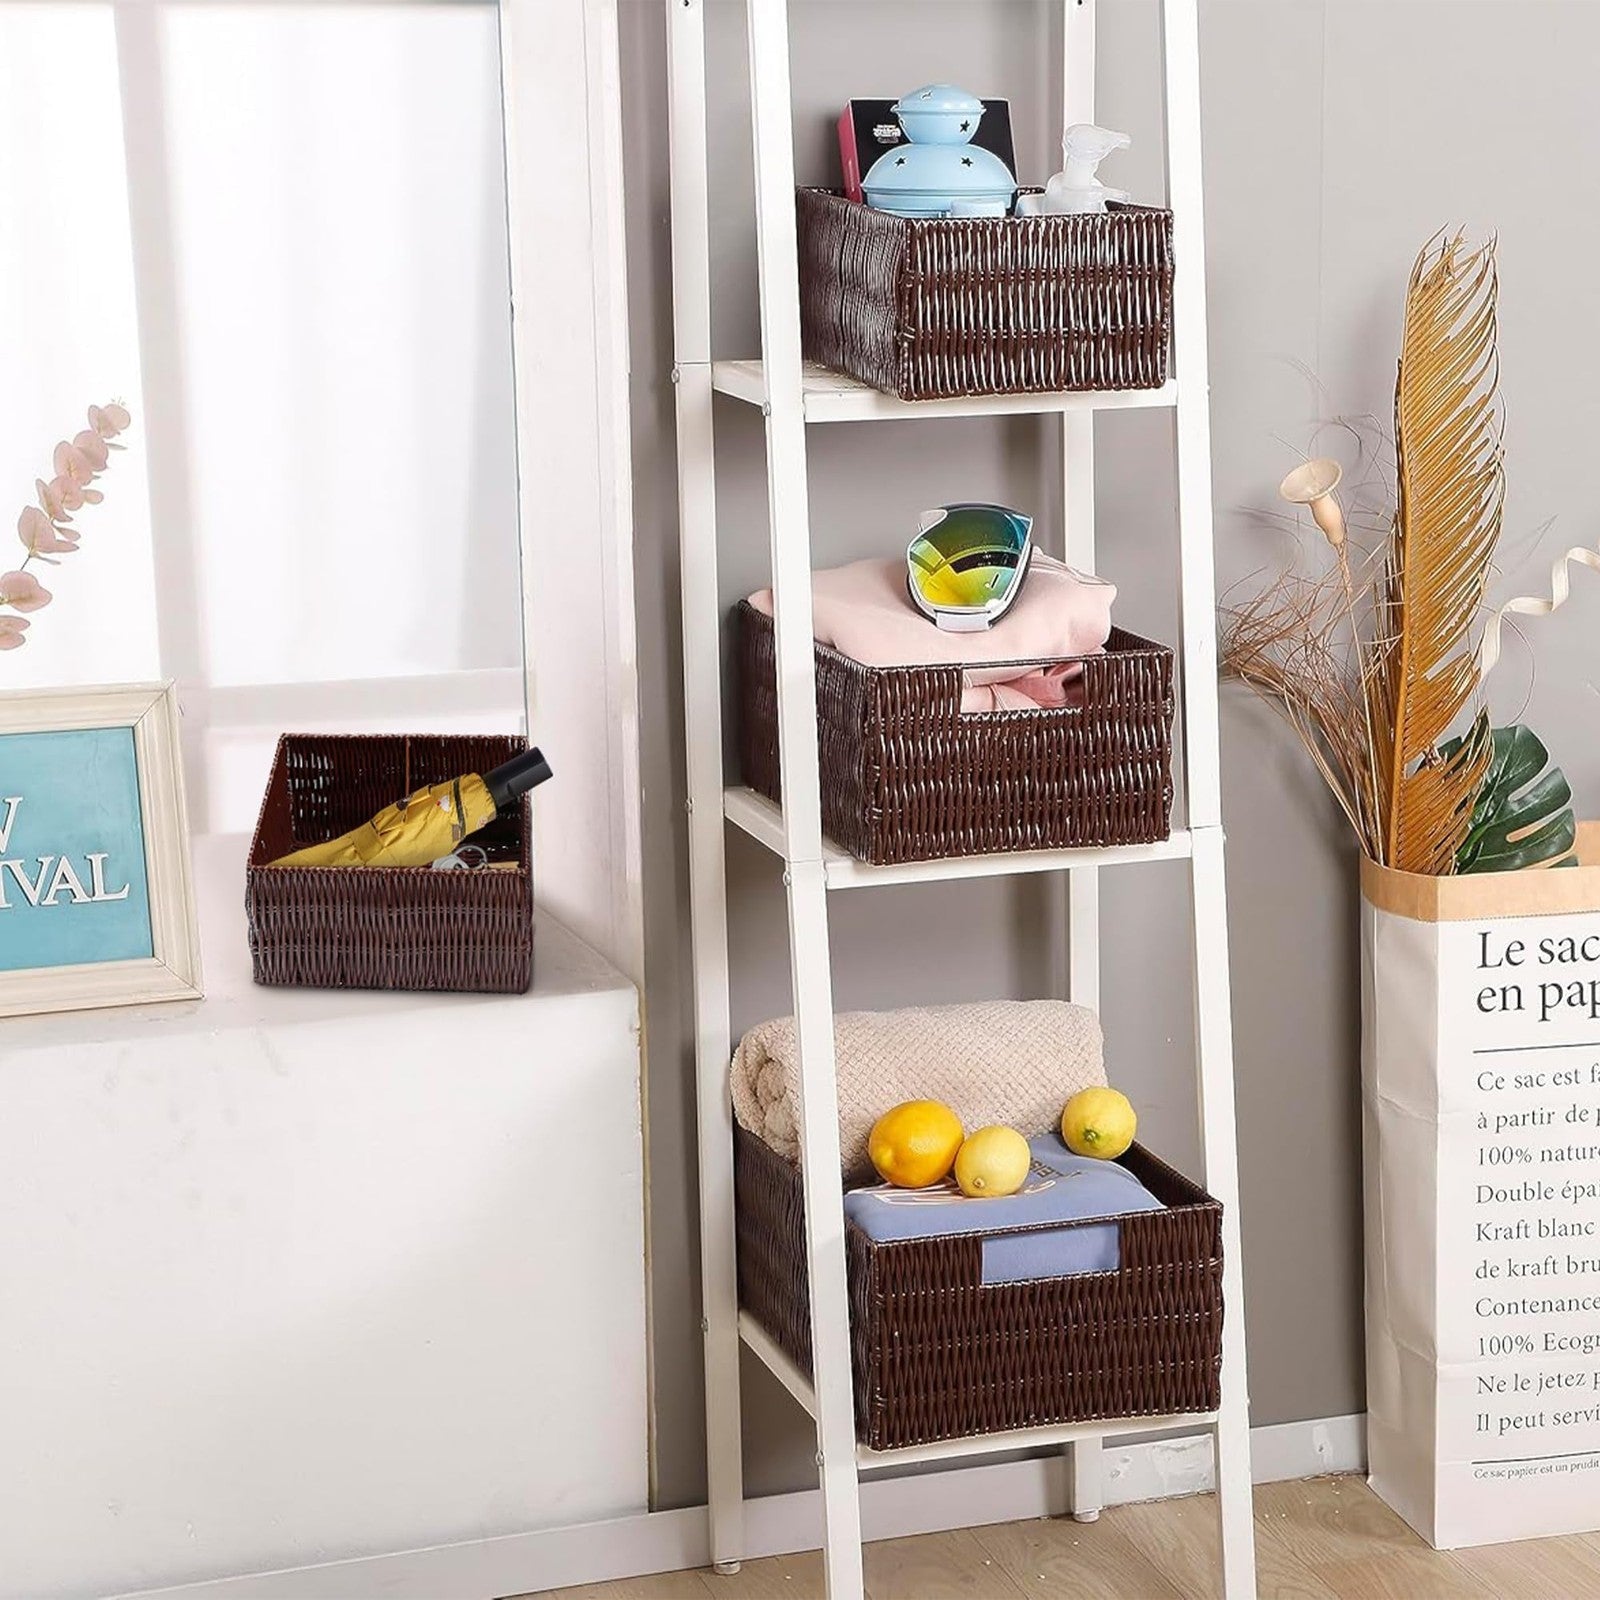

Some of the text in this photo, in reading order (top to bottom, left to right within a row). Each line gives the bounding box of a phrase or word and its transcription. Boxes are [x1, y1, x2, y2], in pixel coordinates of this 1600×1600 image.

[1476, 930, 1600, 970] Le sac
[1476, 984, 1526, 1014] en
[1476, 1071, 1505, 1092] Ce
[1514, 1073, 1546, 1090] sac
[1552, 1068, 1581, 1087] est
[1477, 1111, 1488, 1130] à
[1495, 1105, 1556, 1134] partir
[1564, 1103, 1590, 1124] de
[1479, 1144, 1600, 1167] 100% natur
[1475, 1179, 1600, 1205] Double épa
[1475, 1217, 1595, 1242] Kraft blanc
[1474, 1254, 1600, 1280] de kraft bru
[1475, 1294, 1600, 1318] Contenance
[1479, 1334, 1535, 1357] 100%
[1476, 1375, 1507, 1395] Ne
[1513, 1372, 1531, 1392] le
[1535, 1371, 1587, 1397] jetez
[1498, 1411, 1546, 1437] peut
[1552, 1402, 1600, 1426] servi
[1474, 1468, 1488, 1479] Ce
[1490, 1469, 1506, 1478] sac
[1507, 1465, 1538, 1480] papier
[1540, 1464, 1553, 1474] est
[1555, 1464, 1568, 1472] un
